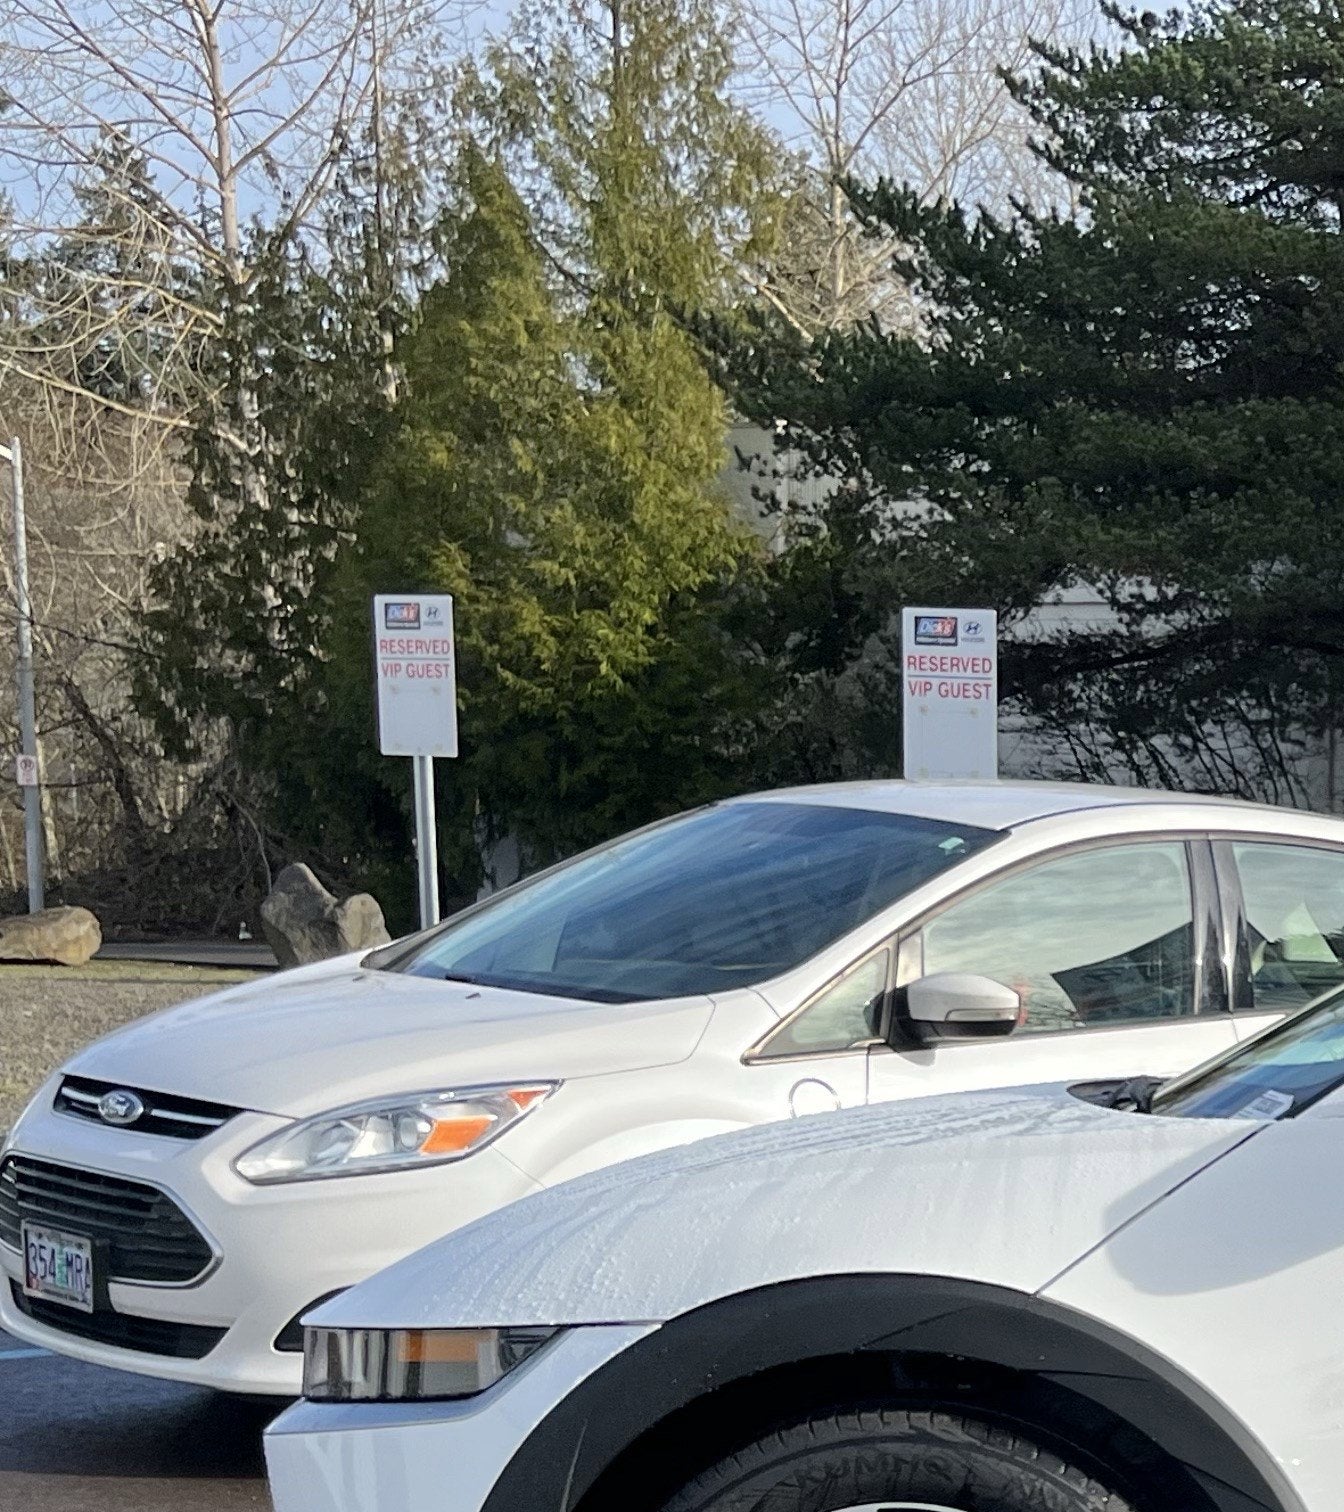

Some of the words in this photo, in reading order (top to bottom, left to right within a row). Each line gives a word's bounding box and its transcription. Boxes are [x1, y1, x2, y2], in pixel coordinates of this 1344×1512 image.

[380, 639, 450, 655] RESERVED
[381, 662, 401, 678] VIP
[406, 662, 450, 679] GUEST
[907, 655, 992, 673] RESERVED
[908, 681, 932, 697] VIP
[938, 681, 992, 700] GUEST
[28, 1242, 57, 1280] 354
